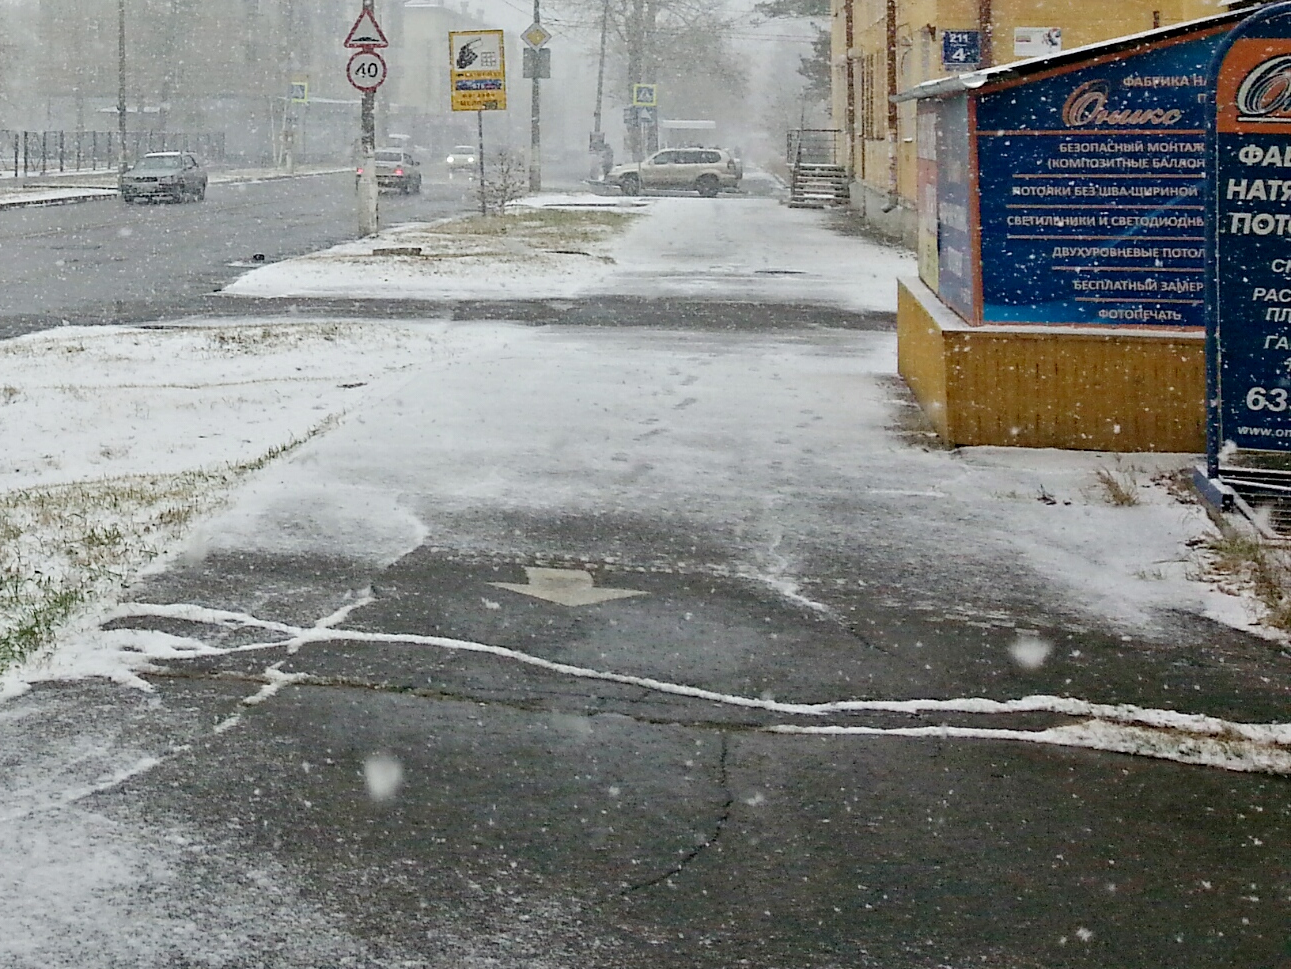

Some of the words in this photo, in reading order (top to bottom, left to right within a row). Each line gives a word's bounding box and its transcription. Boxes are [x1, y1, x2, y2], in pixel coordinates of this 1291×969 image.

[950, 34, 969, 43] 211
[952, 48, 966, 61] 4
[355, 63, 378, 78] 40
[1123, 76, 1190, 87] ФАБРИКА
[1062, 79, 1182, 127] Оникс
[1060, 141, 1144, 153] БЕЗОПАСНЫЙ
[1147, 143, 1205, 153] МОНТАЖ
[1074, 186, 1096, 197] БЕЗ
[1007, 216, 1096, 228] СВЕТИЛЬНИКИ
[1099, 217, 1108, 226] И
[1227, 212, 1291, 236] ПОТ
[1051, 246, 1160, 259] ДВУХУРОВНЕВЫЕ
[1074, 278, 1158, 291] БЕСПЛАТНЫЙ
[1098, 308, 1182, 321] ФОТОПЕЧАТЬ
[1263, 335, 1291, 350] ГА
[1247, 387, 1291, 412] 63
